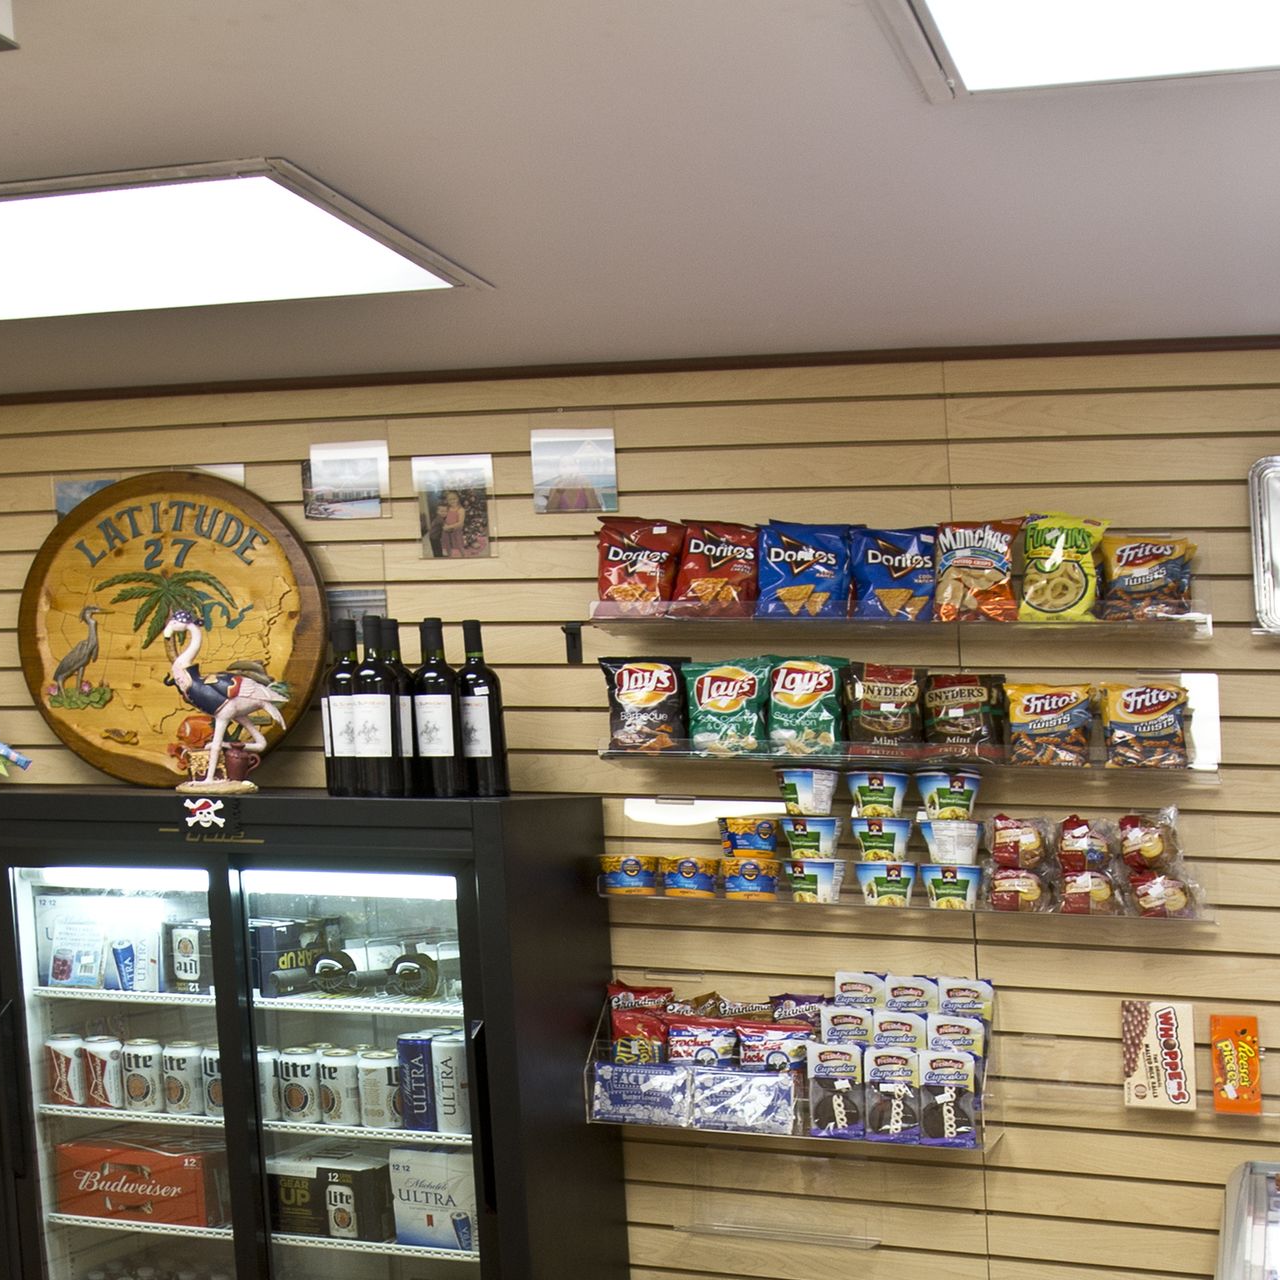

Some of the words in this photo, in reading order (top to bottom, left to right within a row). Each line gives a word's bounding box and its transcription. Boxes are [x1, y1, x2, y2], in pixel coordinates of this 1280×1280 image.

[74, 500, 270, 568] LATITUDE
[938, 527, 1011, 553] Munchos
[144, 538, 198, 570] 27
[608, 546, 670, 564] Doritos
[689, 538, 755, 562] Doritos
[1116, 542, 1173, 565] Fritos
[868, 549, 933, 568] Doritos
[622, 662, 672, 695] Lay's
[773, 668, 834, 696] Lay's
[701, 674, 751, 703] Lay's
[862, 683, 916, 698] SNYDER'S
[927, 687, 985, 702] SNYDER'S
[1023, 692, 1077, 715] Fritos
[1122, 686, 1178, 712] Fritos
[773, 710, 795, 721] Sour
[1028, 715, 1070, 731] TWISTS
[1134, 716, 1175, 733] TWISTS
[872, 736, 898, 746] Mini
[945, 735, 970, 744] Mini
[278, 951, 297, 969] UP
[835, 994, 876, 1005] Cupcakes
[886, 1000, 928, 1009] Cupcakes
[827, 1028, 868, 1038] Cupcakes
[874, 1034, 916, 1044] Cupcakes
[932, 1037, 974, 1048] Cupcakes
[122, 1052, 153, 1072] Lite
[741, 1052, 765, 1063] Jack
[280, 1060, 311, 1081] Lite
[814, 1064, 856, 1075] Cupcakes
[870, 1068, 913, 1079] Cupcakes
[925, 1072, 968, 1082] Cupcakes
[411, 1056, 427, 1114] ULTRA
[441, 1058, 457, 1116] ULTRA
[620, 1073, 644, 1085] ACT
[184, 1158, 197, 1167] 12
[392, 1163, 401, 1171] 12
[401, 1164, 411, 1172] 12
[73, 1169, 182, 1197] Budweiser
[280, 1178, 310, 1190] GEAR
[328, 1172, 339, 1182] 12
[281, 1190, 311, 1206] UP
[328, 1190, 353, 1206] Lite
[398, 1188, 458, 1207] ULTRA
